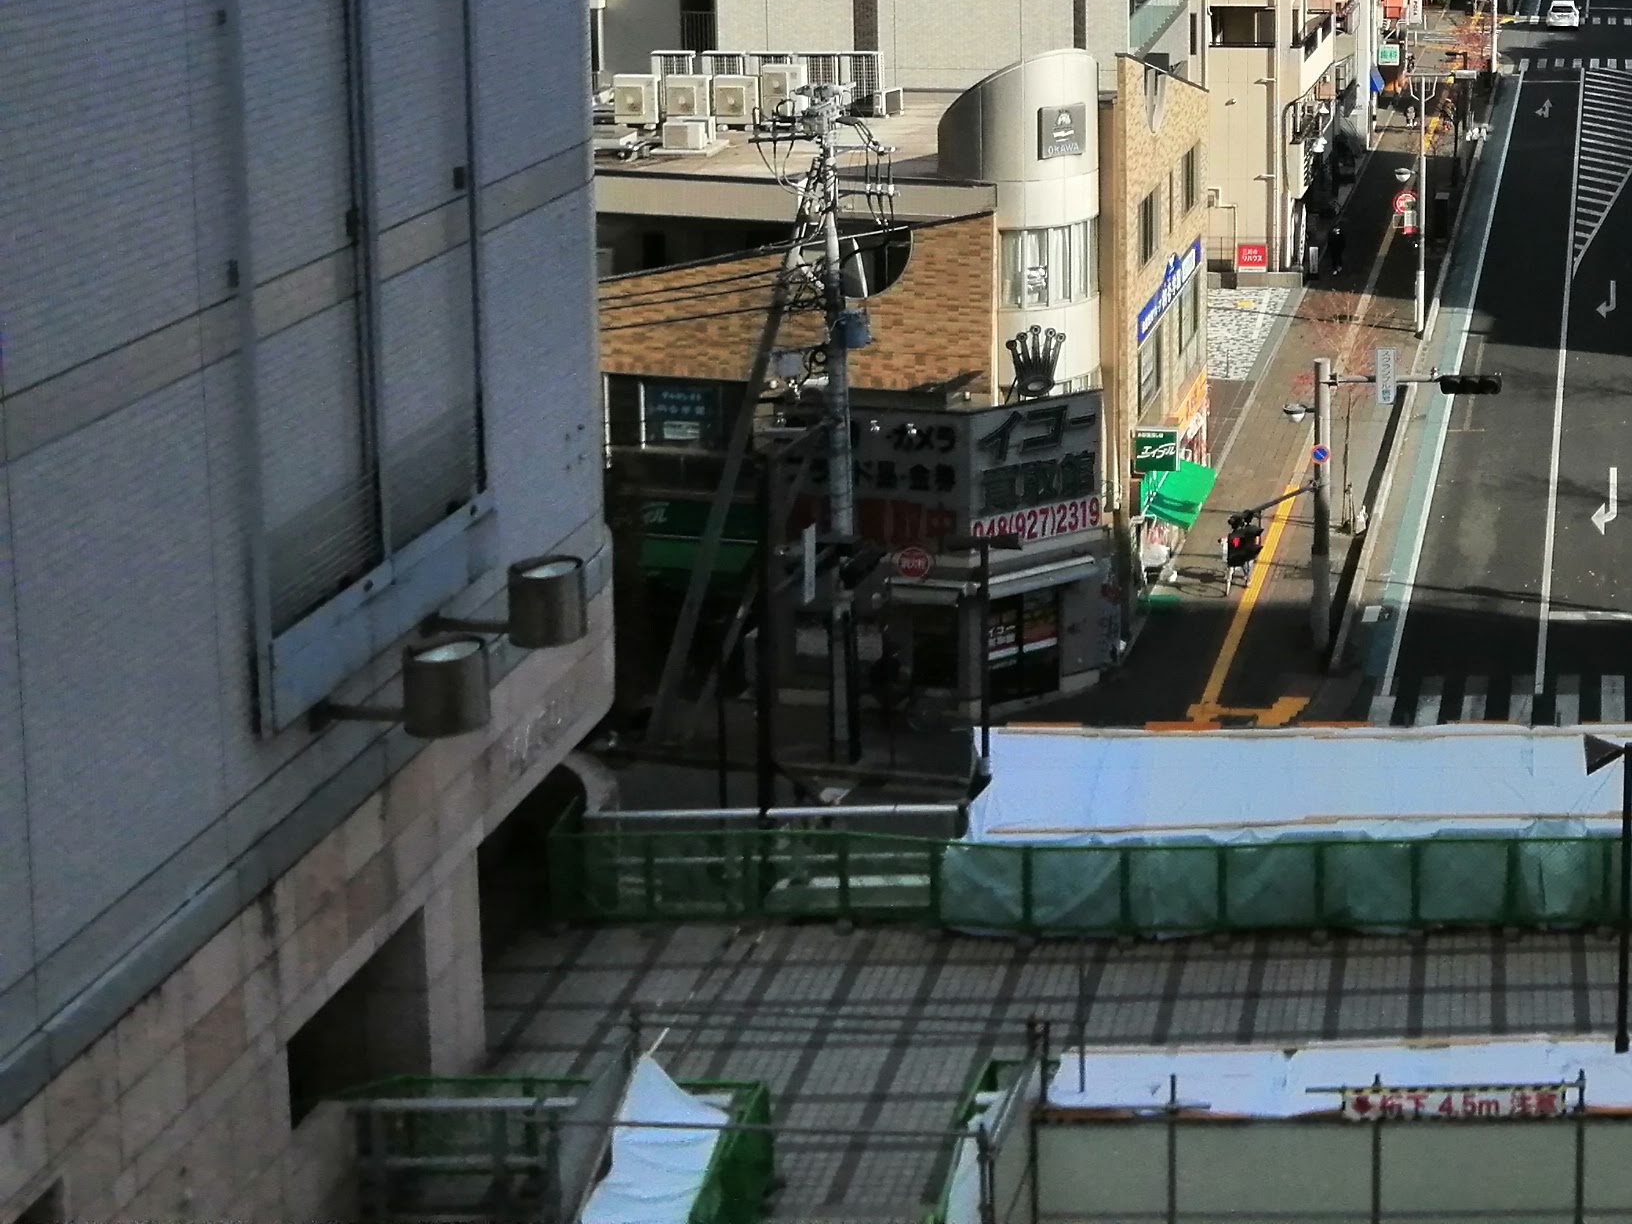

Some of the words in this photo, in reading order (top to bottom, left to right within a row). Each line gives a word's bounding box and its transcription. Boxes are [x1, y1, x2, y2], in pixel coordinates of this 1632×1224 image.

[1047, 143, 1079, 154] OKAWA
[977, 404, 1096, 462] イコー
[1136, 443, 1176, 459] エイブル
[1380, 1093, 1428, 1117] 桁下
[1438, 1094, 1499, 1116] 4.5m
[1510, 1091, 1557, 1115] 注意
